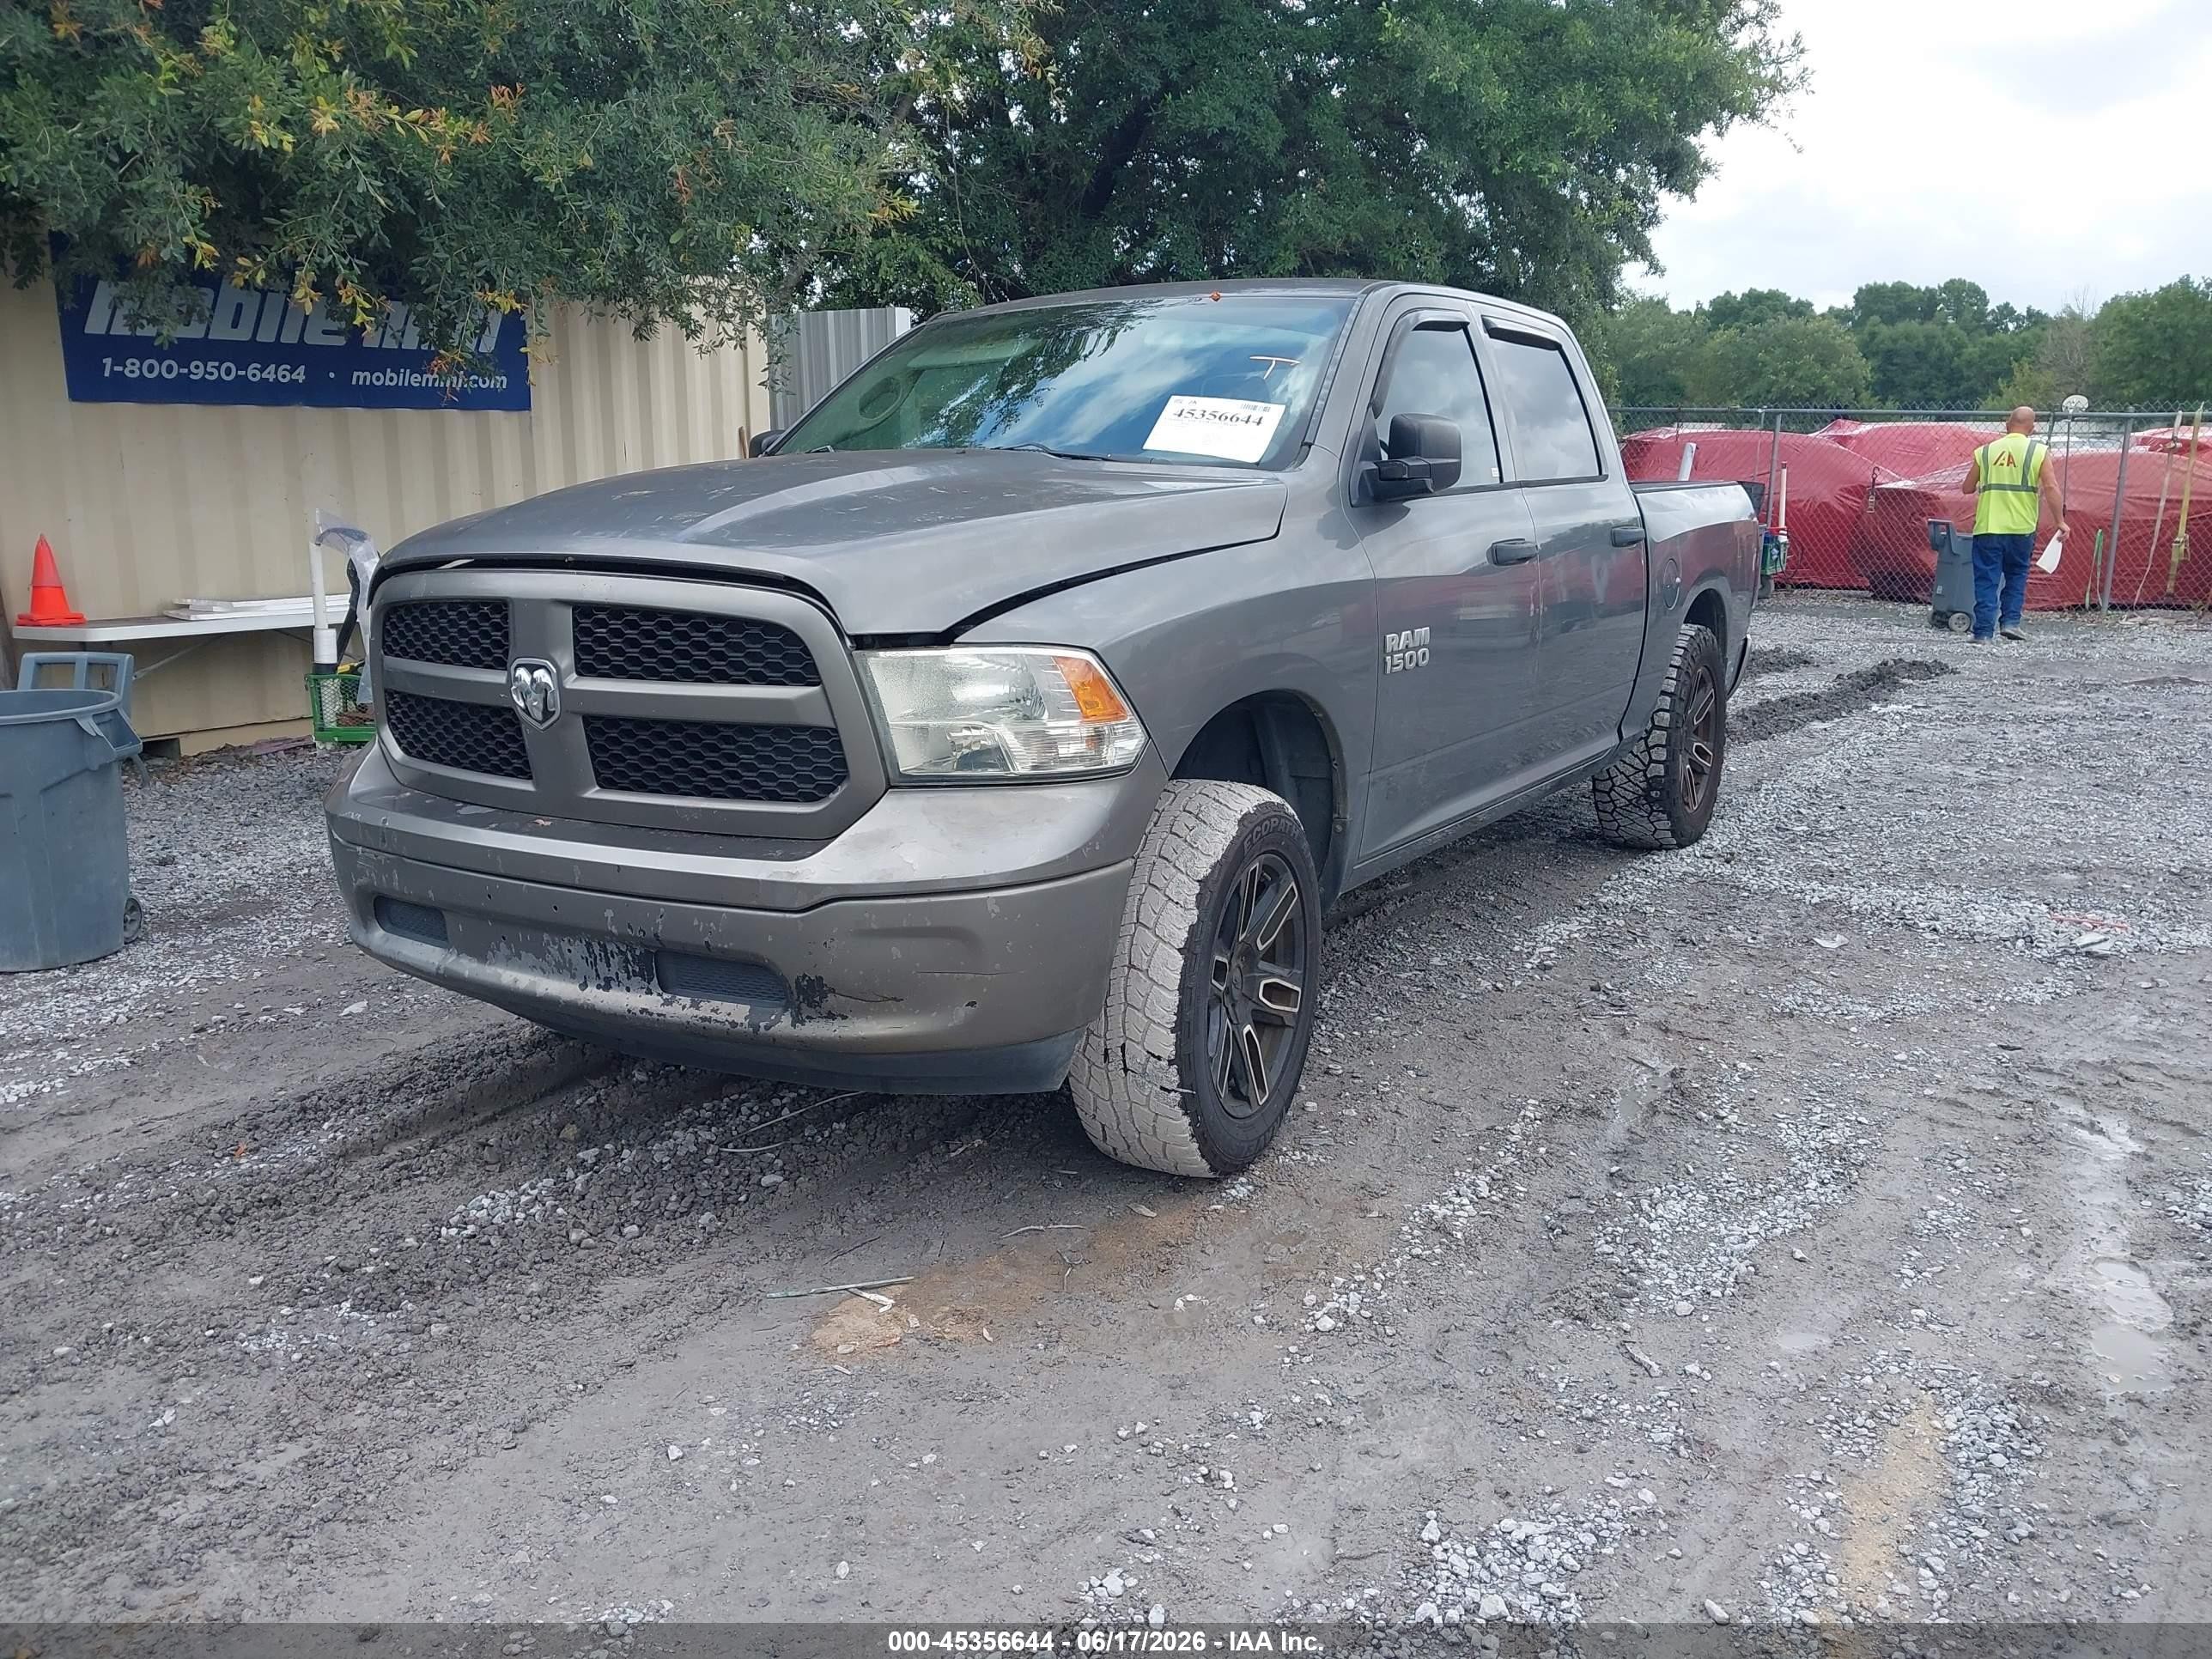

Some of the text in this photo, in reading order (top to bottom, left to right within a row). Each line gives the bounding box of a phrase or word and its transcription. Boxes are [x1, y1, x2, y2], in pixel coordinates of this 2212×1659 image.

[102, 356, 306, 384] 1-800-950-6464
[1173, 408, 1264, 426] 45356644
[1385, 627, 1430, 653] RAM
[1385, 647, 1430, 674] 1500
[1243, 817, 1300, 854] ECOPATH
